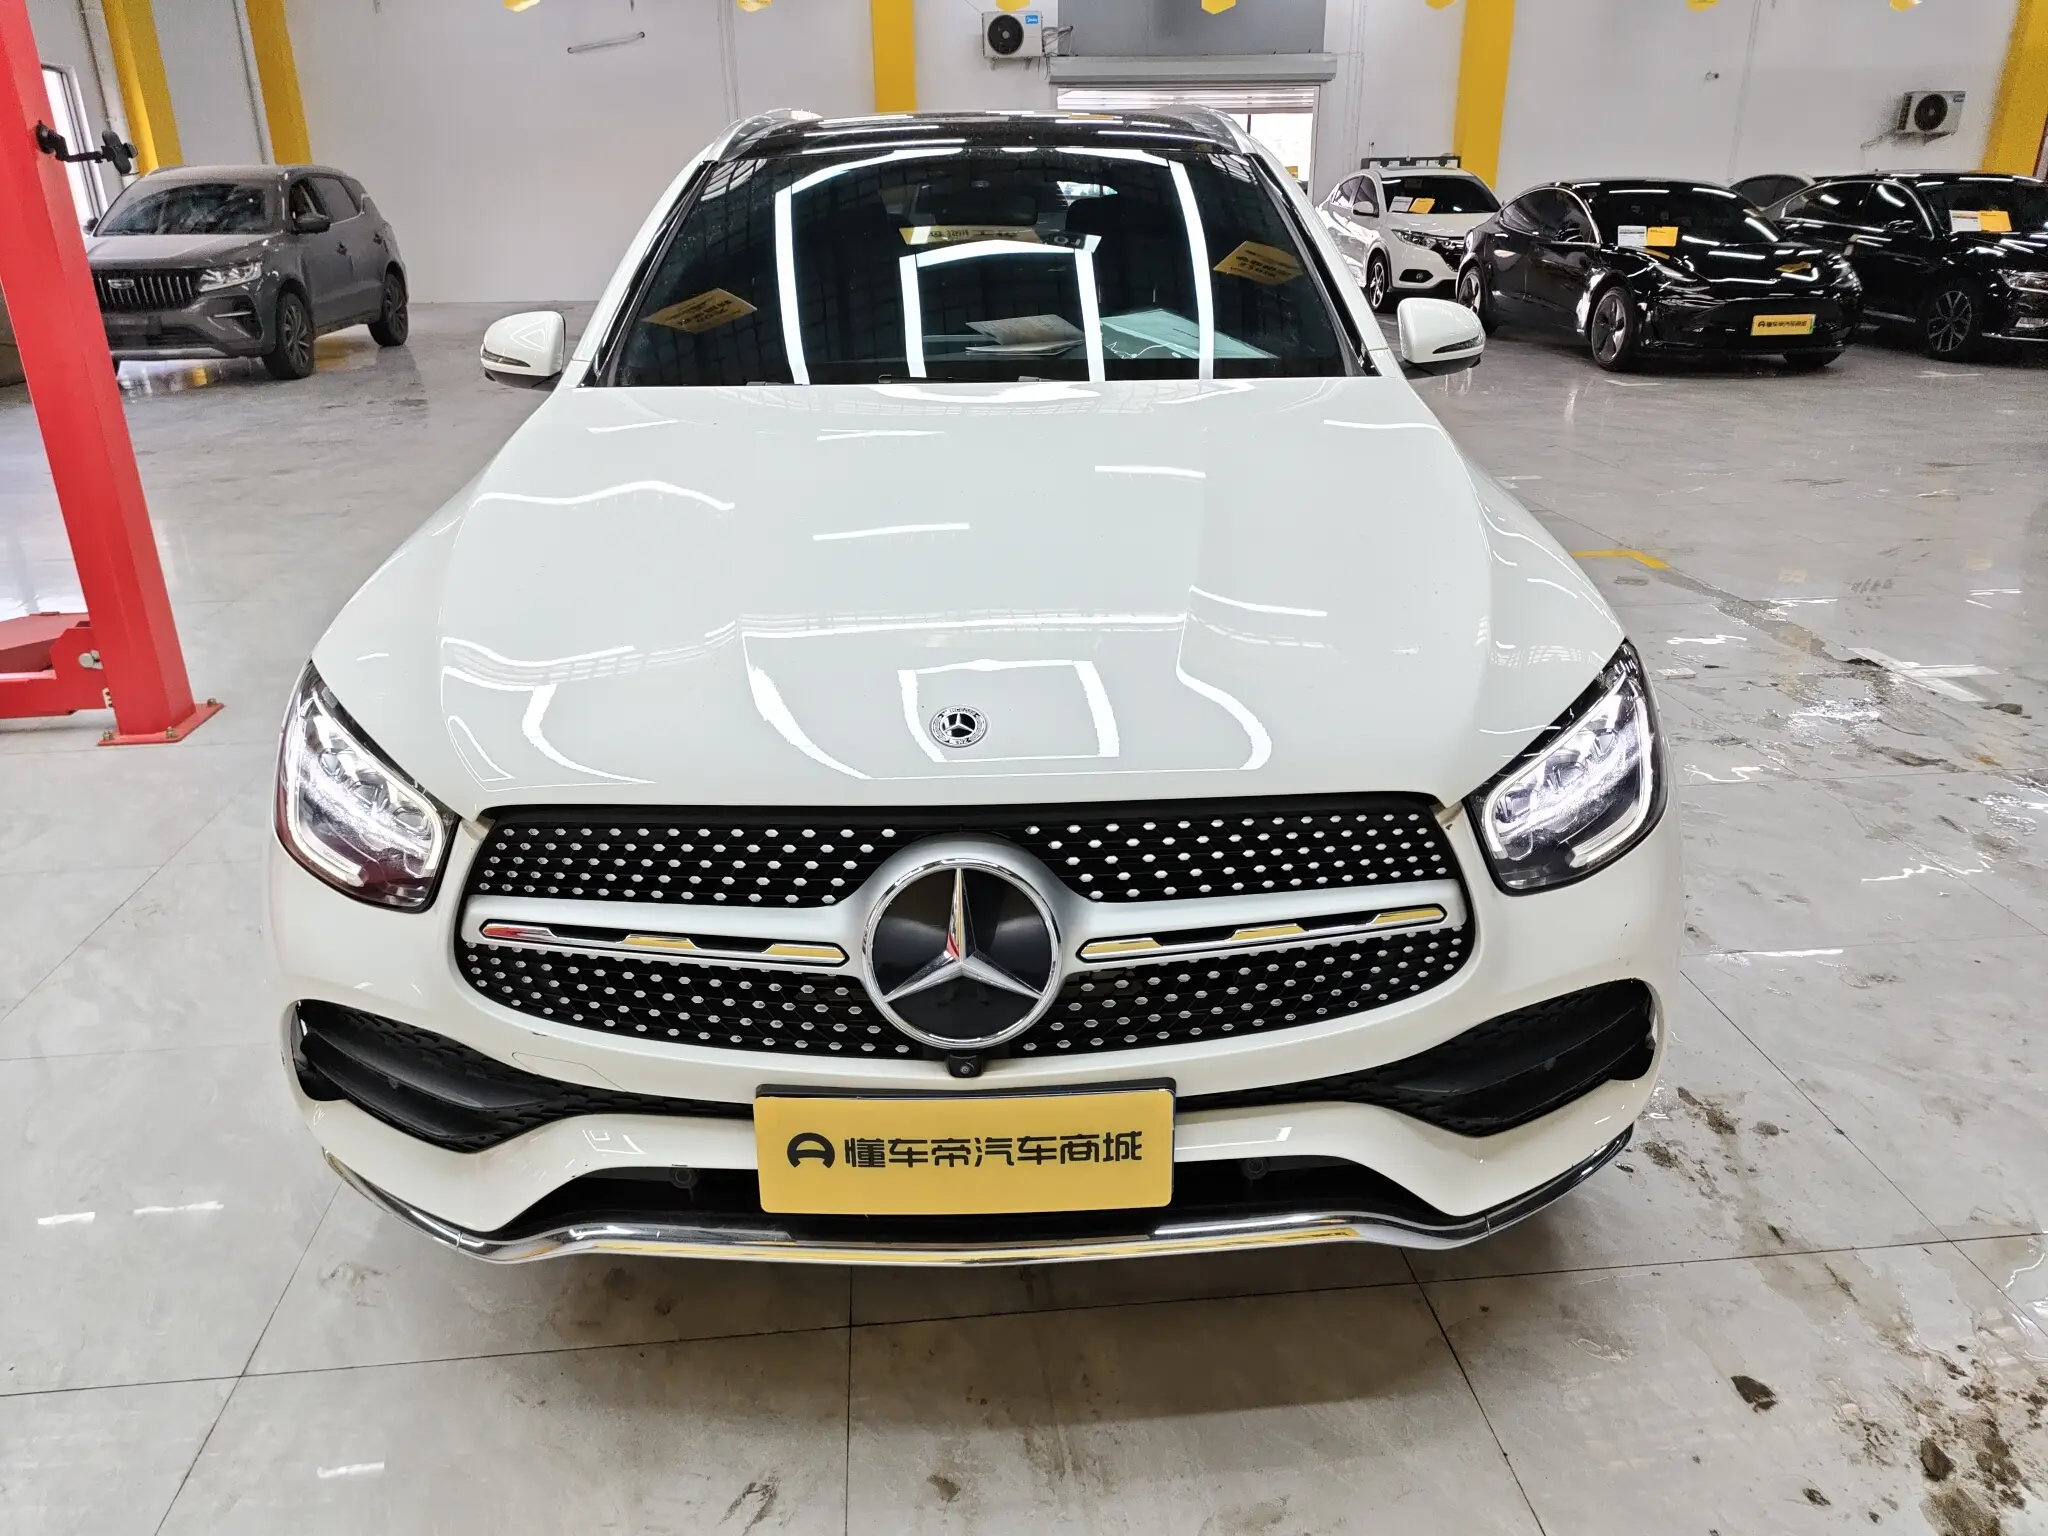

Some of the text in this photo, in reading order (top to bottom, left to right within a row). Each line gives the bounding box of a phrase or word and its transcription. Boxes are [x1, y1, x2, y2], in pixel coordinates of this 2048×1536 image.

[845, 1131, 1143, 1168] 懂车帝汽车商城
